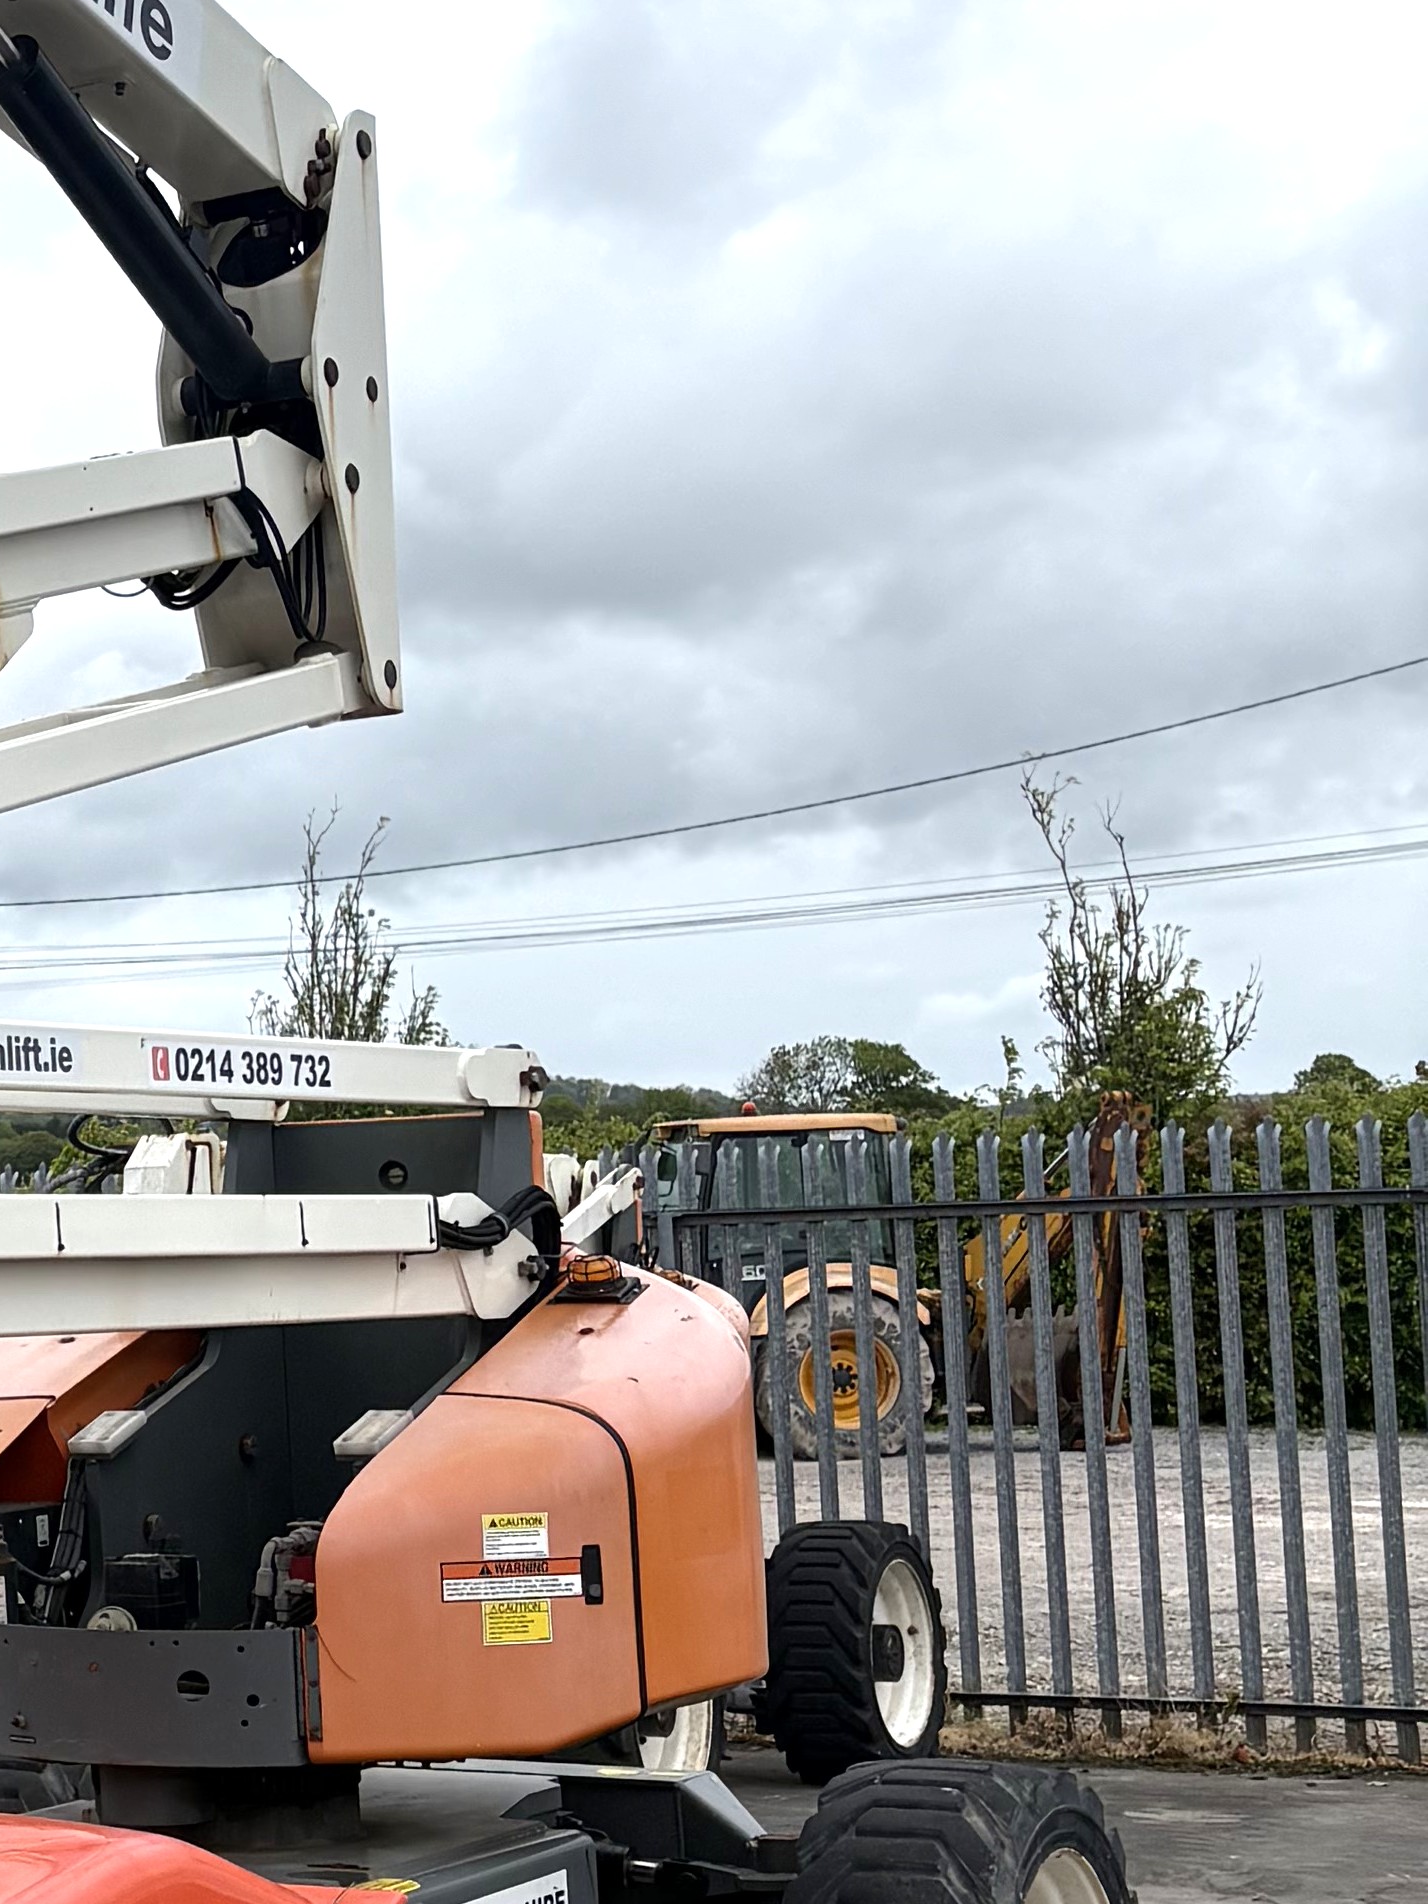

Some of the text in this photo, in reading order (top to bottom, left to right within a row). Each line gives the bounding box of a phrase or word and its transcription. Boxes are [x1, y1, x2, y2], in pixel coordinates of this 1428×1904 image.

[174, 1047, 234, 1085] 0214
[241, 1051, 283, 1087] 389
[291, 1054, 332, 1089] 732
[498, 1516, 543, 1528] CAUTION
[494, 1560, 549, 1575] WARNING
[497, 1601, 541, 1614] CAUTION
